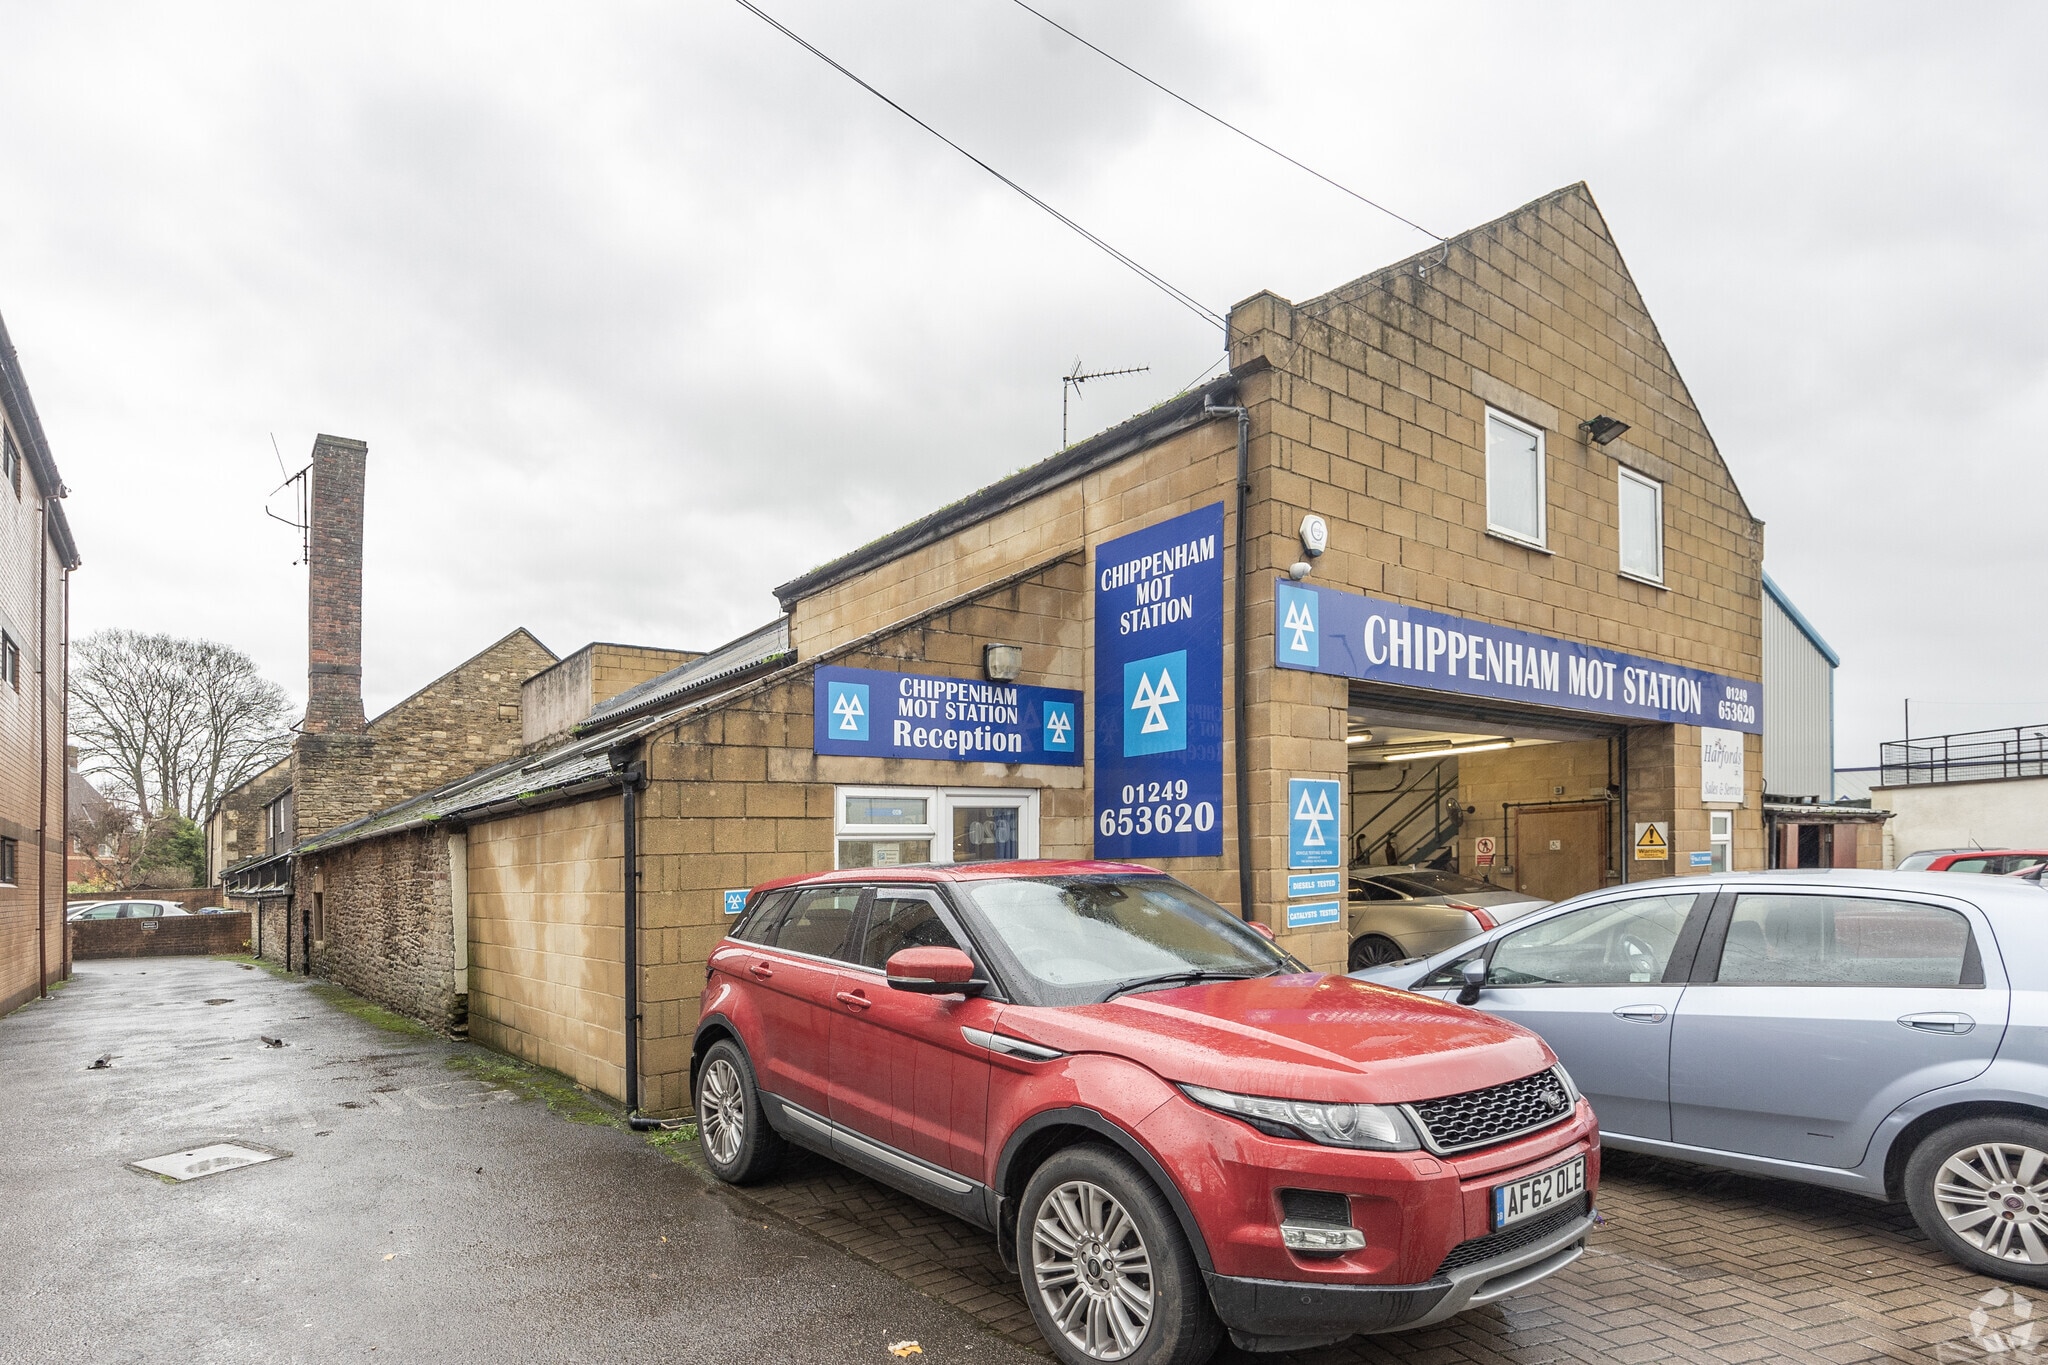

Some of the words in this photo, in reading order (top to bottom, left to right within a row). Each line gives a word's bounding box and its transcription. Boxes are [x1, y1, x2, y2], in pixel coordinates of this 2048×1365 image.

[1101, 534, 1215, 591] CHIPPENHAM
[1136, 573, 1174, 606] MOT
[1120, 594, 1192, 635] STATION
[1364, 615, 1559, 692] CHIPPENHAM
[1568, 655, 1617, 701] MOT
[1623, 666, 1701, 715] STATION
[899, 678, 1017, 705] CHIPPENHAM
[1725, 686, 1748, 703] 01249
[898, 697, 939, 719] MOT
[945, 701, 1018, 724] STATION
[1718, 700, 1756, 724] 653620
[893, 720, 1022, 755] Reception
[1703, 744, 1742, 769] Harfords
[1122, 779, 1188, 804] 01249
[1704, 781, 1718, 794] Sales
[1100, 801, 1215, 837] 653620
[1290, 911, 1317, 920] CATALYSTS
[1319, 909, 1337, 917] TESTED
[1508, 1175, 1552, 1217] AF62
[1557, 1161, 1581, 1198] OLE
